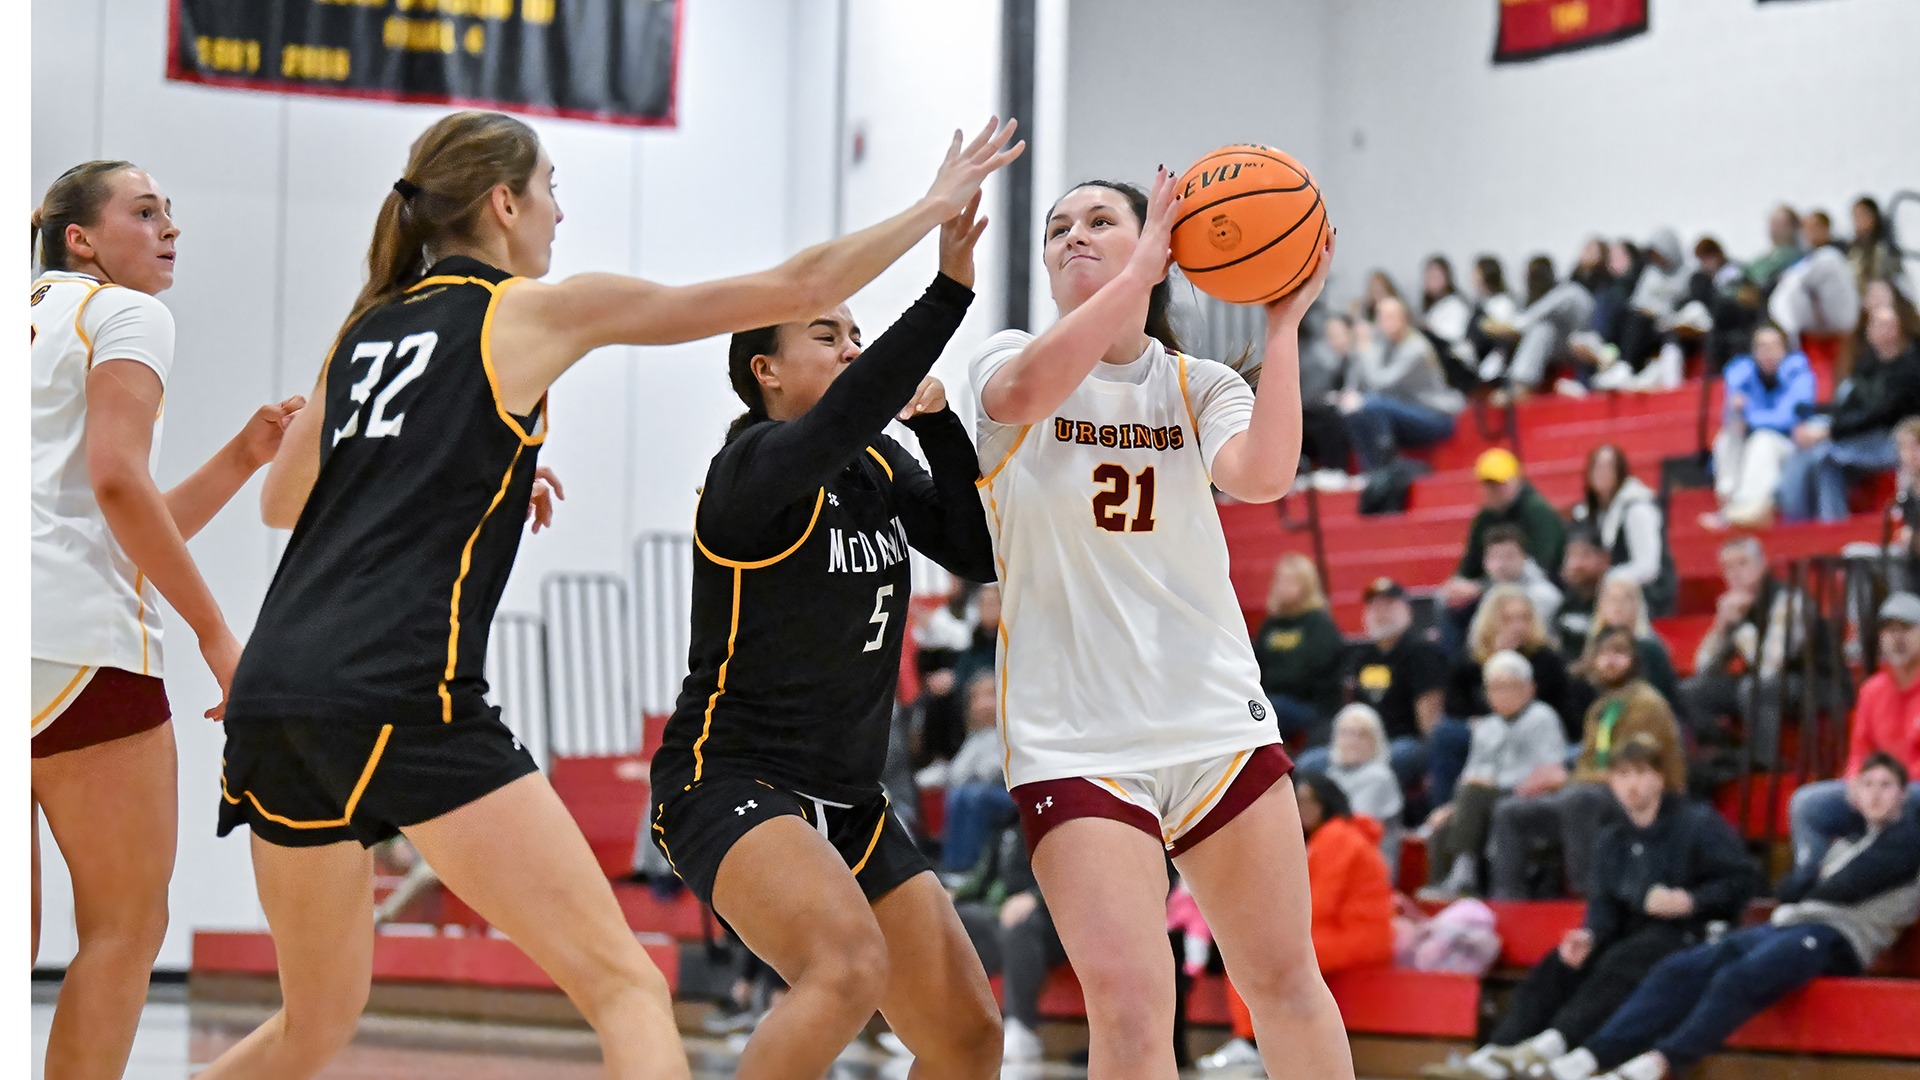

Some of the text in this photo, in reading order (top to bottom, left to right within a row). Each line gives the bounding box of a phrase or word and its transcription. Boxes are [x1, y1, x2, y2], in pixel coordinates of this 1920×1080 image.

[1184, 162, 1242, 199] EVO
[332, 331, 439, 448] 32
[1055, 417, 1184, 451] URSINUS
[1092, 462, 1157, 533] 21
[862, 583, 894, 653] 5
